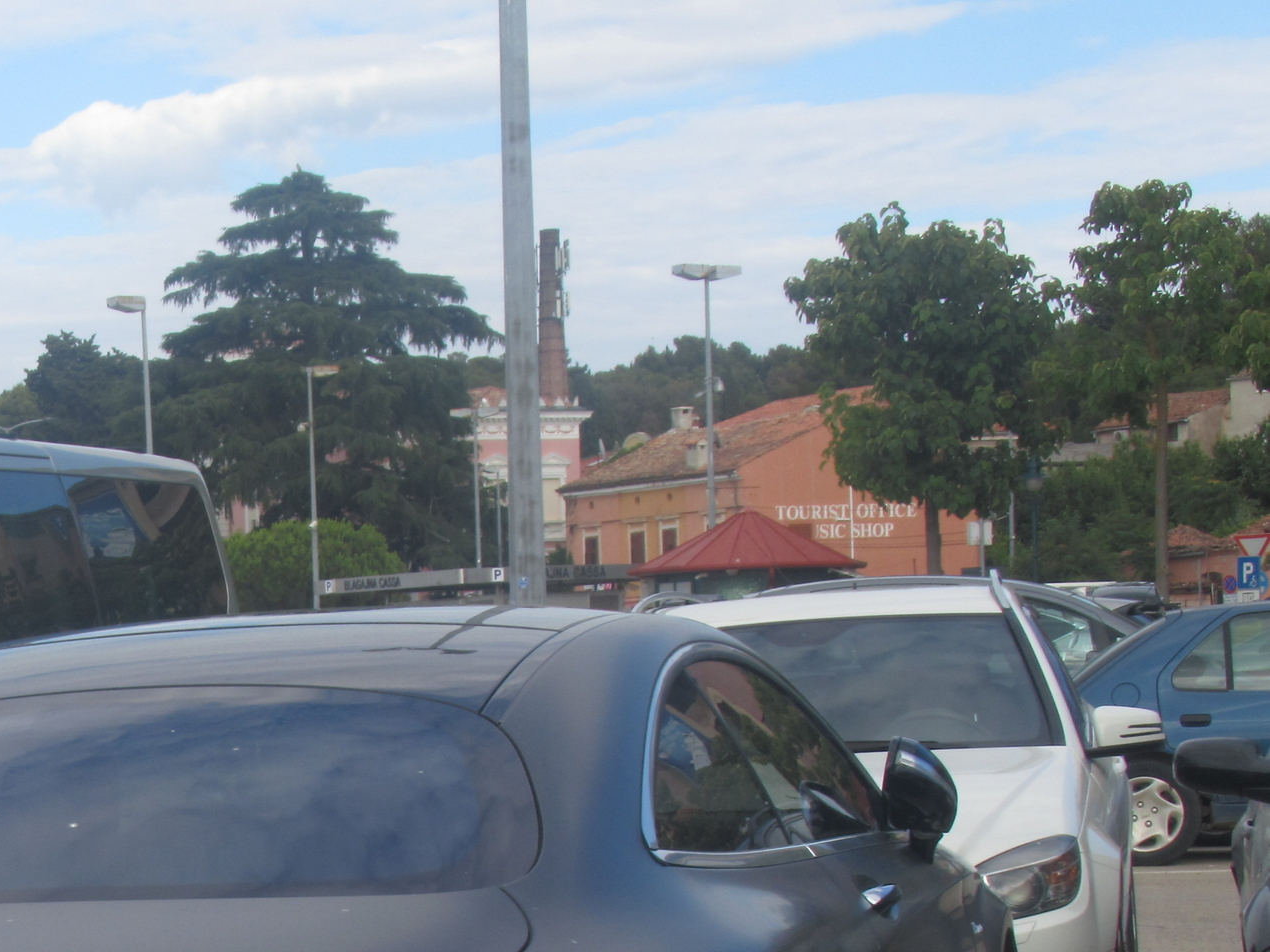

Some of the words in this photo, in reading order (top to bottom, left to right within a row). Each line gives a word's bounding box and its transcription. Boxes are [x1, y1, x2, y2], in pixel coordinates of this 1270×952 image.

[775, 503, 849, 520] TOURIST
[816, 524, 845, 539] SIC
[851, 523, 894, 538] SHOP
[494, 569, 502, 580] P
[573, 566, 607, 578] CASSA
[1242, 562, 1254, 584] P
[344, 578, 378, 591] BLAGAJNA
[378, 576, 402, 589] CASSA
